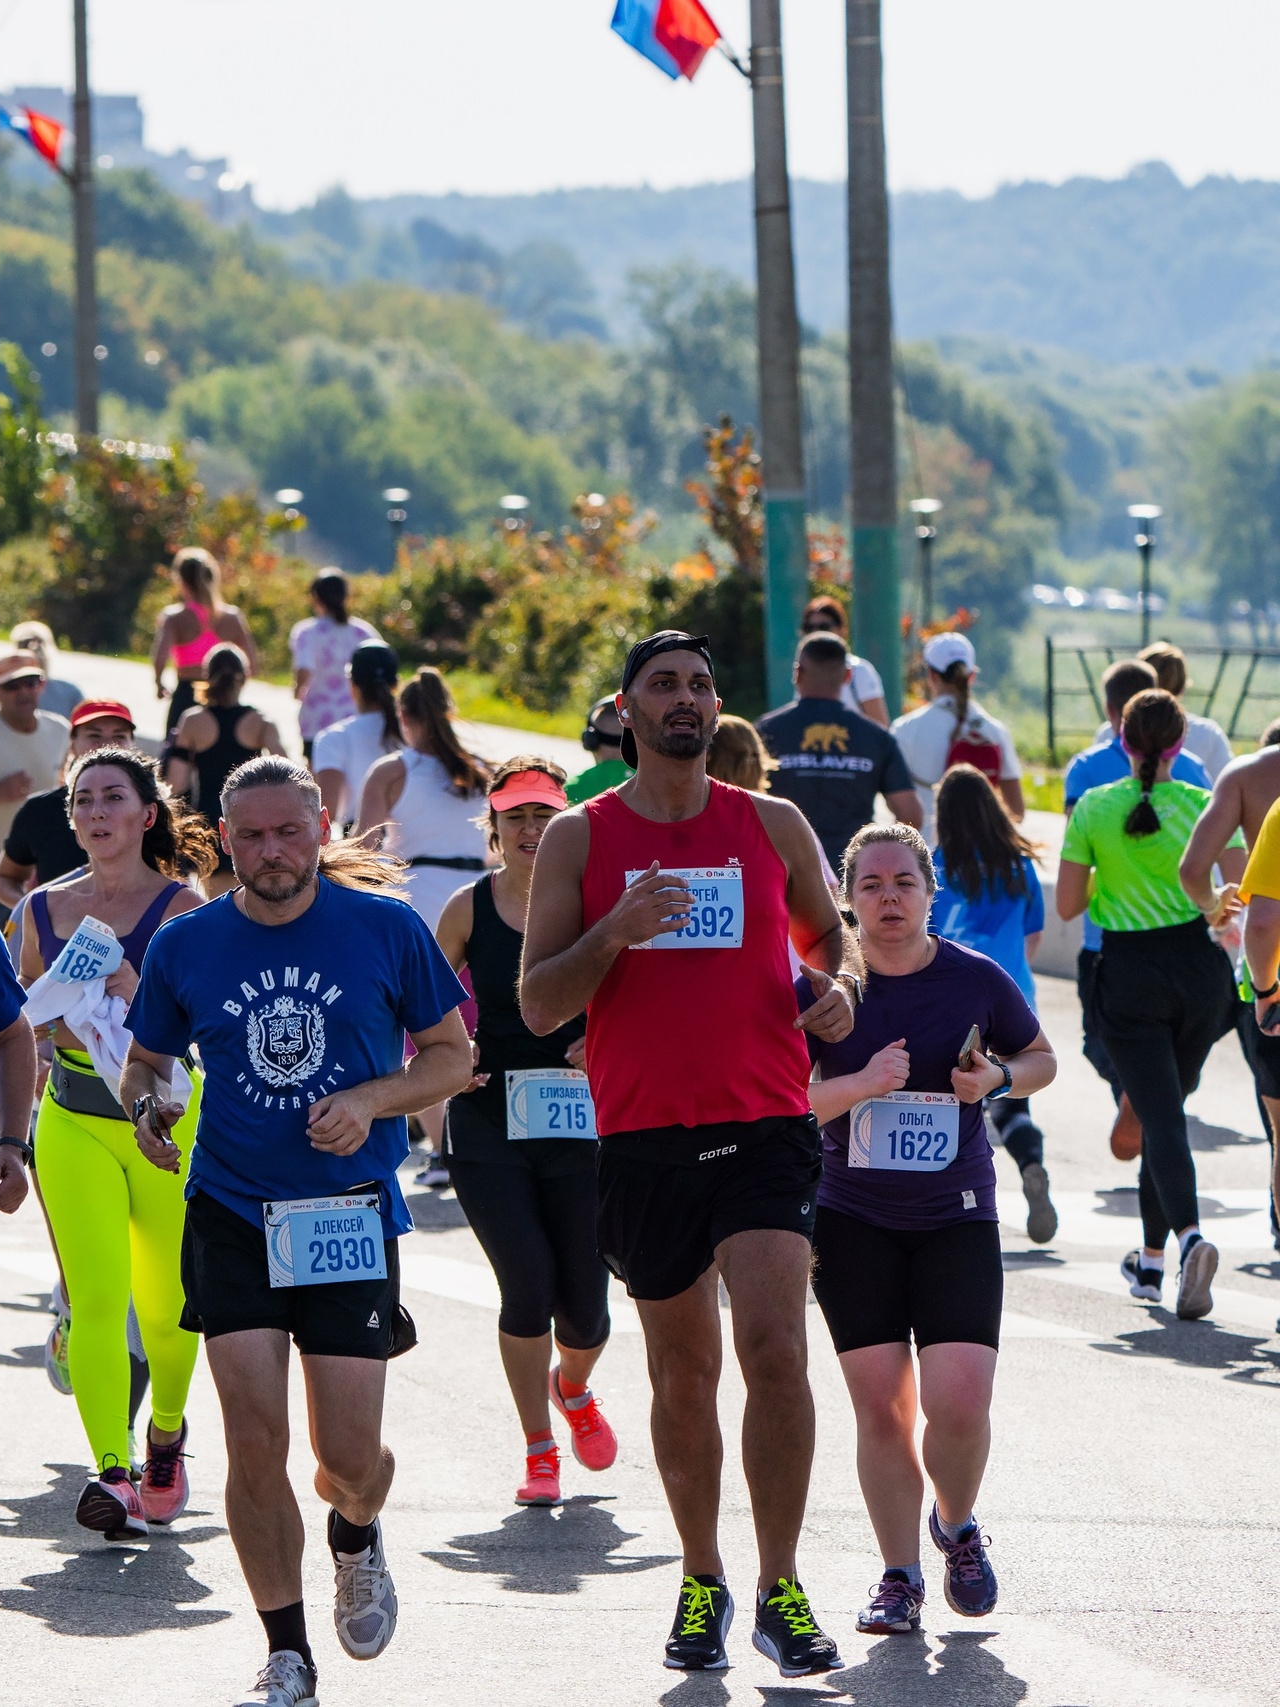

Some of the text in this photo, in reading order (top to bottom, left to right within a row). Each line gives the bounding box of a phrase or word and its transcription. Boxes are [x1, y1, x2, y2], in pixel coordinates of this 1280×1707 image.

[680, 886, 718, 901] РГЕЙ
[60, 949, 102, 981] 185
[222, 966, 343, 1017] BAUMAN
[277, 1054, 298, 1066] 1830
[236, 1063, 345, 1110] UNIVERSITY
[540, 1086, 590, 1100] ЕЛИЗАВЕТА
[548, 1102, 587, 1130] 215
[899, 1112, 933, 1126] ОЛЬГА
[888, 1130, 949, 1161] 1622
[314, 1216, 365, 1235] АЛЕКСЕЙ
[308, 1236, 376, 1274] 2930
